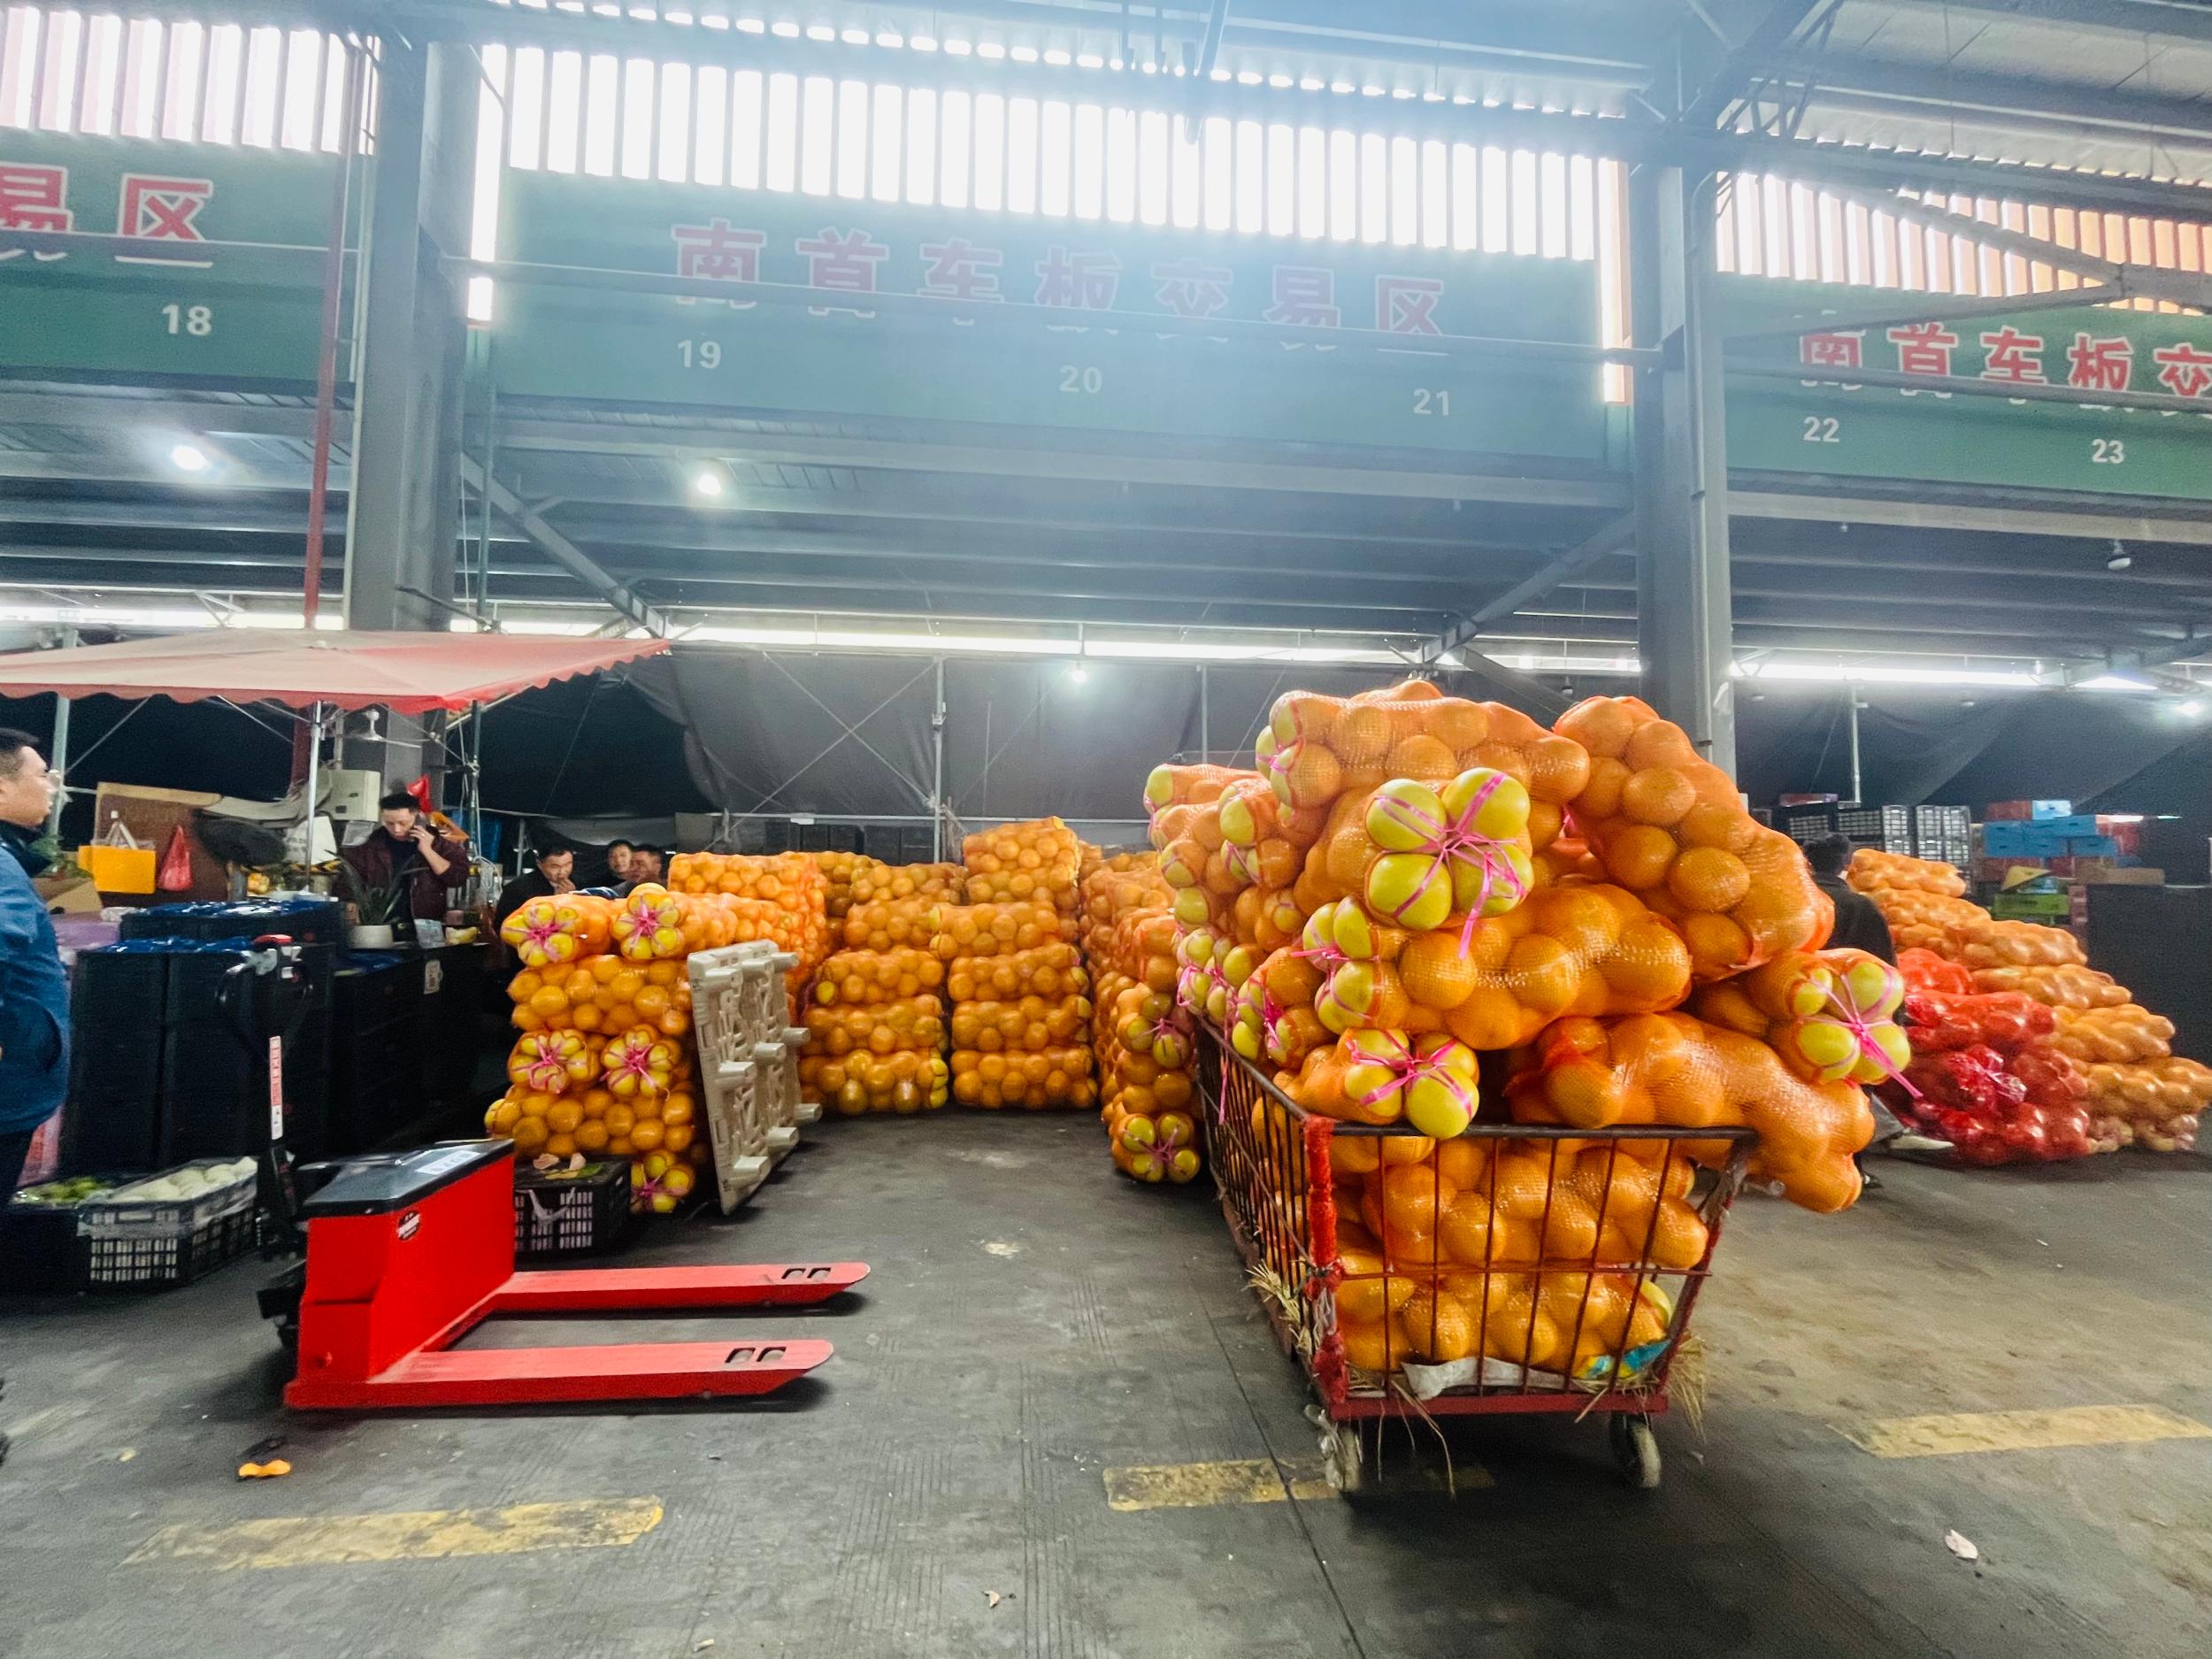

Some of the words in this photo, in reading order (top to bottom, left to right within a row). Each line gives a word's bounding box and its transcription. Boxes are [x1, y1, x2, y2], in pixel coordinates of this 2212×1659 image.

[671, 218, 1448, 356] 南首车板交易区
[162, 303, 212, 336] 18
[677, 340, 722, 369] 19
[1059, 366, 1102, 393] 20
[1413, 388, 1450, 416] 21
[1803, 417, 1840, 442] 22
[2091, 439, 2125, 465] 23
